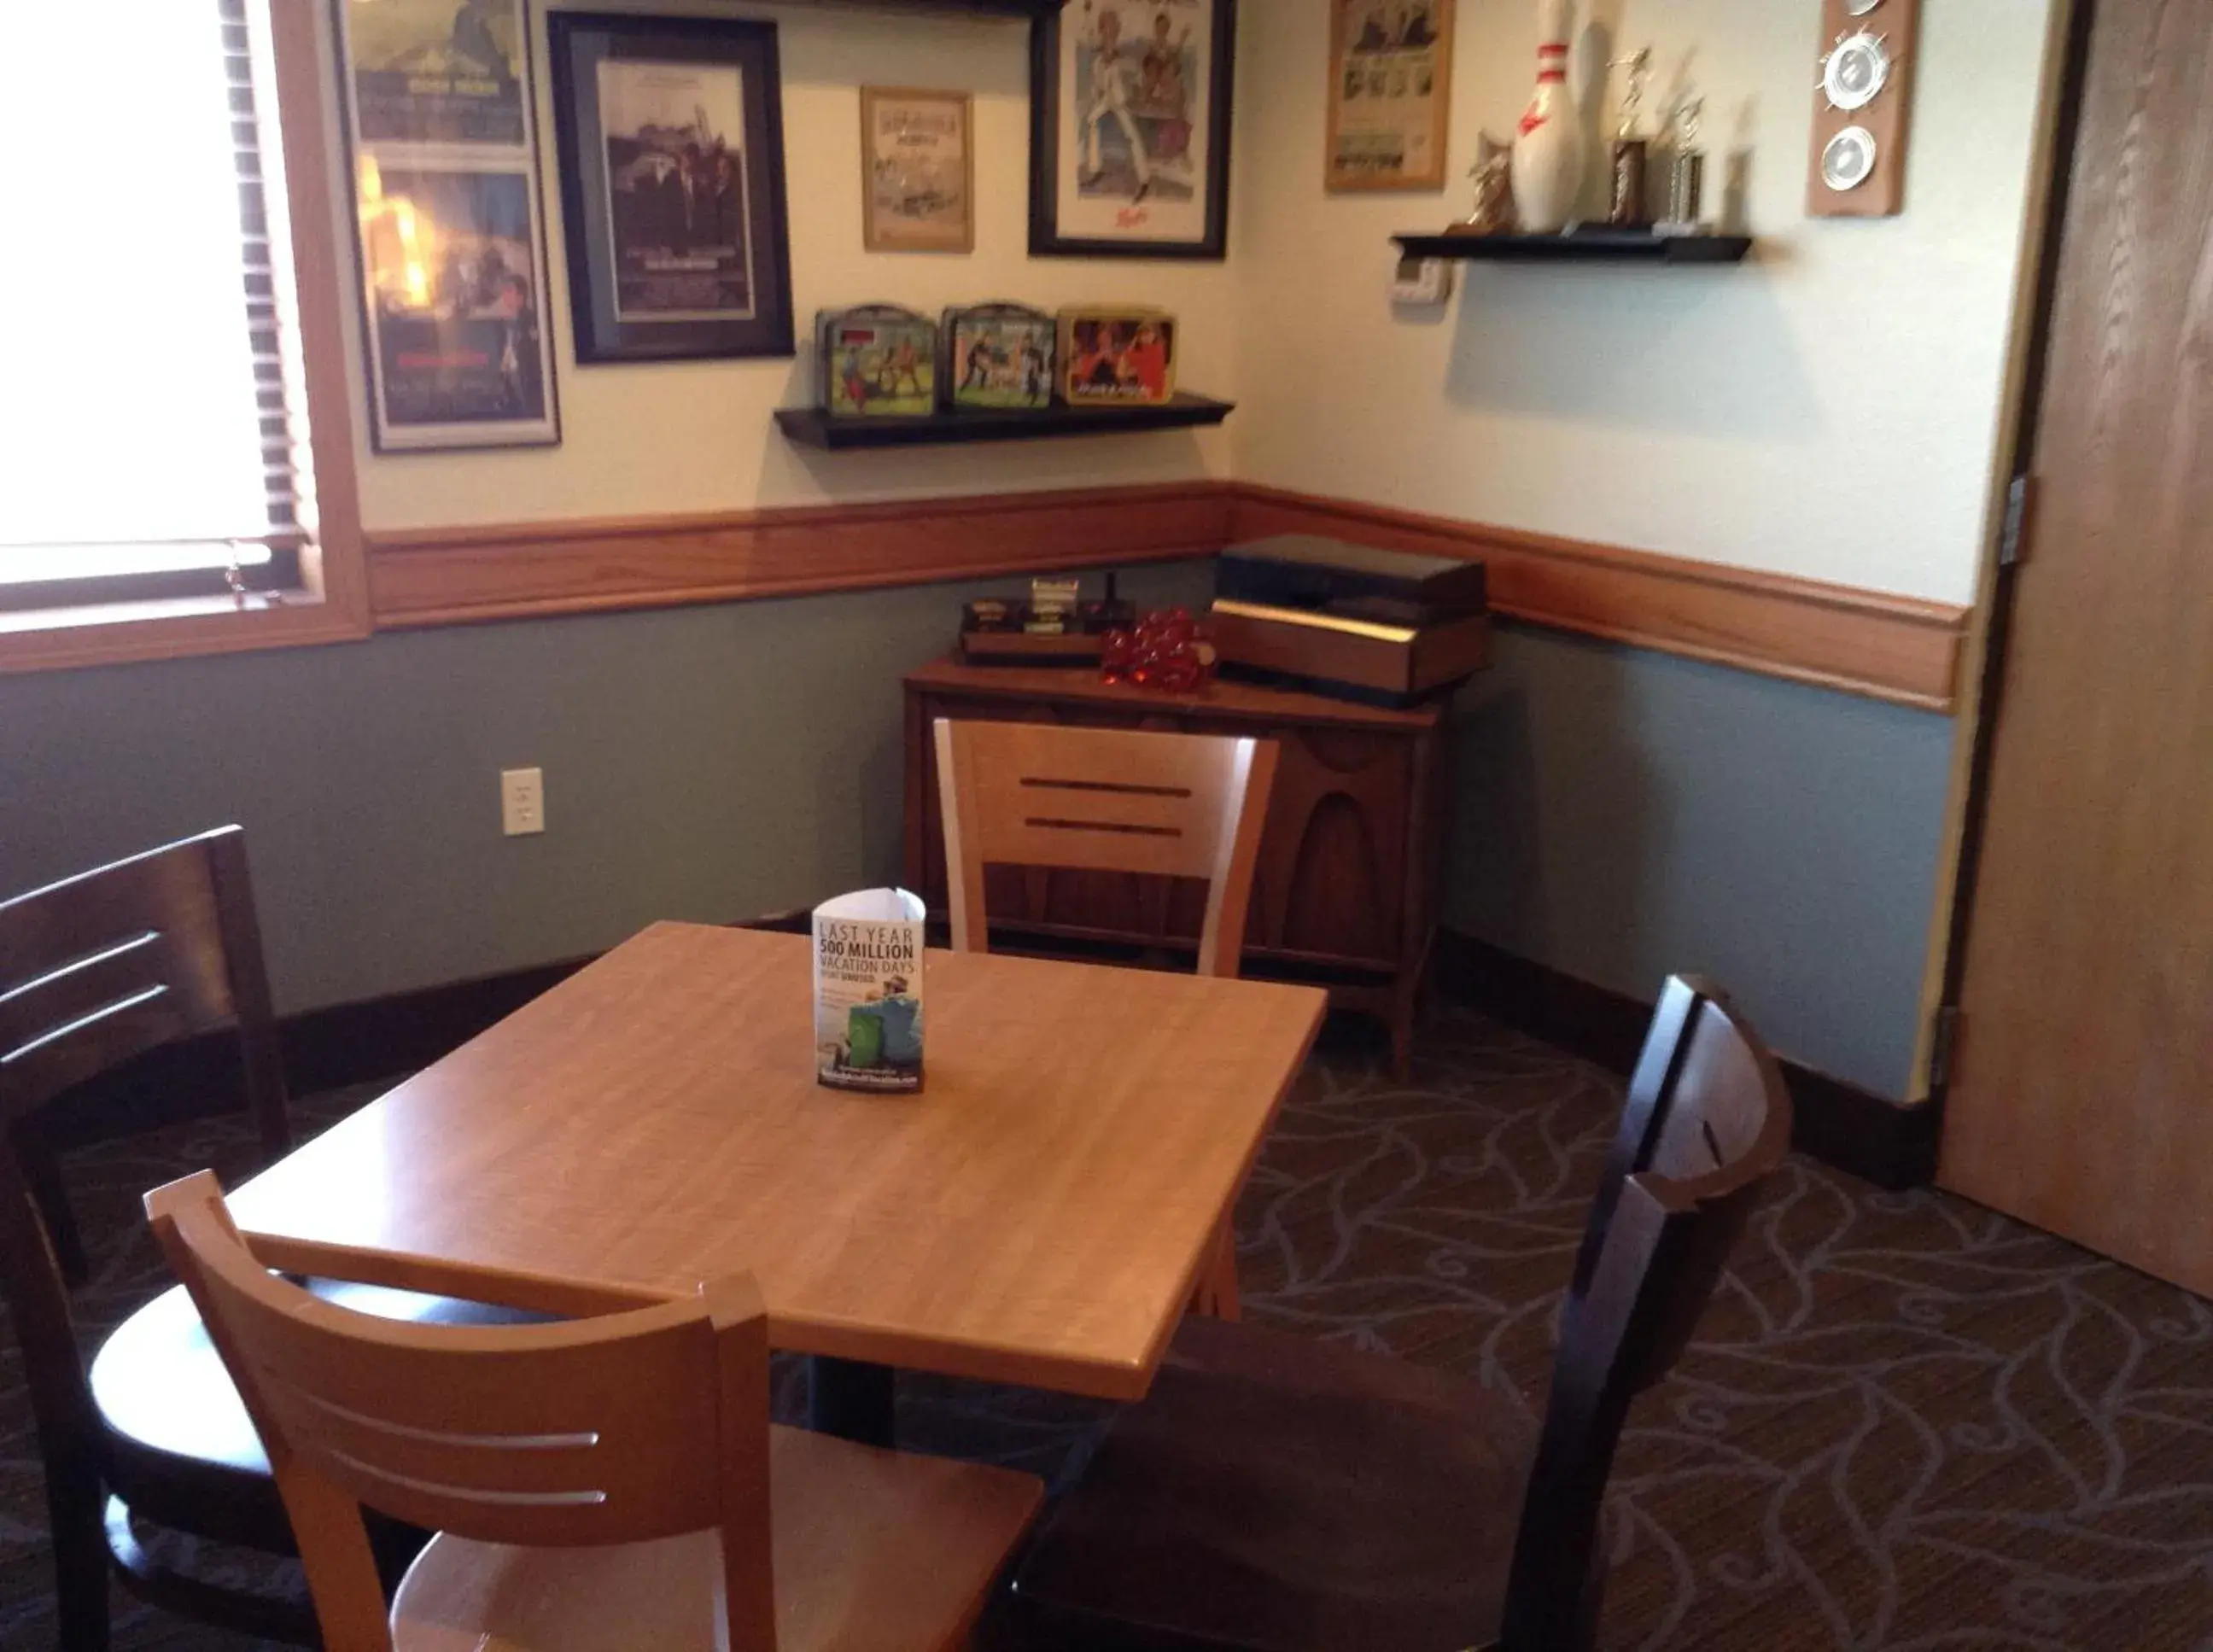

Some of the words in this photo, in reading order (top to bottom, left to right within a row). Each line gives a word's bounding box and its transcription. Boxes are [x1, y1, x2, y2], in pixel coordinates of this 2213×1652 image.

[820, 922, 857, 941] LAST
[867, 927, 913, 943] YEAR
[820, 939, 844, 955] 500
[848, 943, 914, 960] MILLION
[820, 955, 878, 972] VACATION
[882, 961, 914, 973] DAYS
